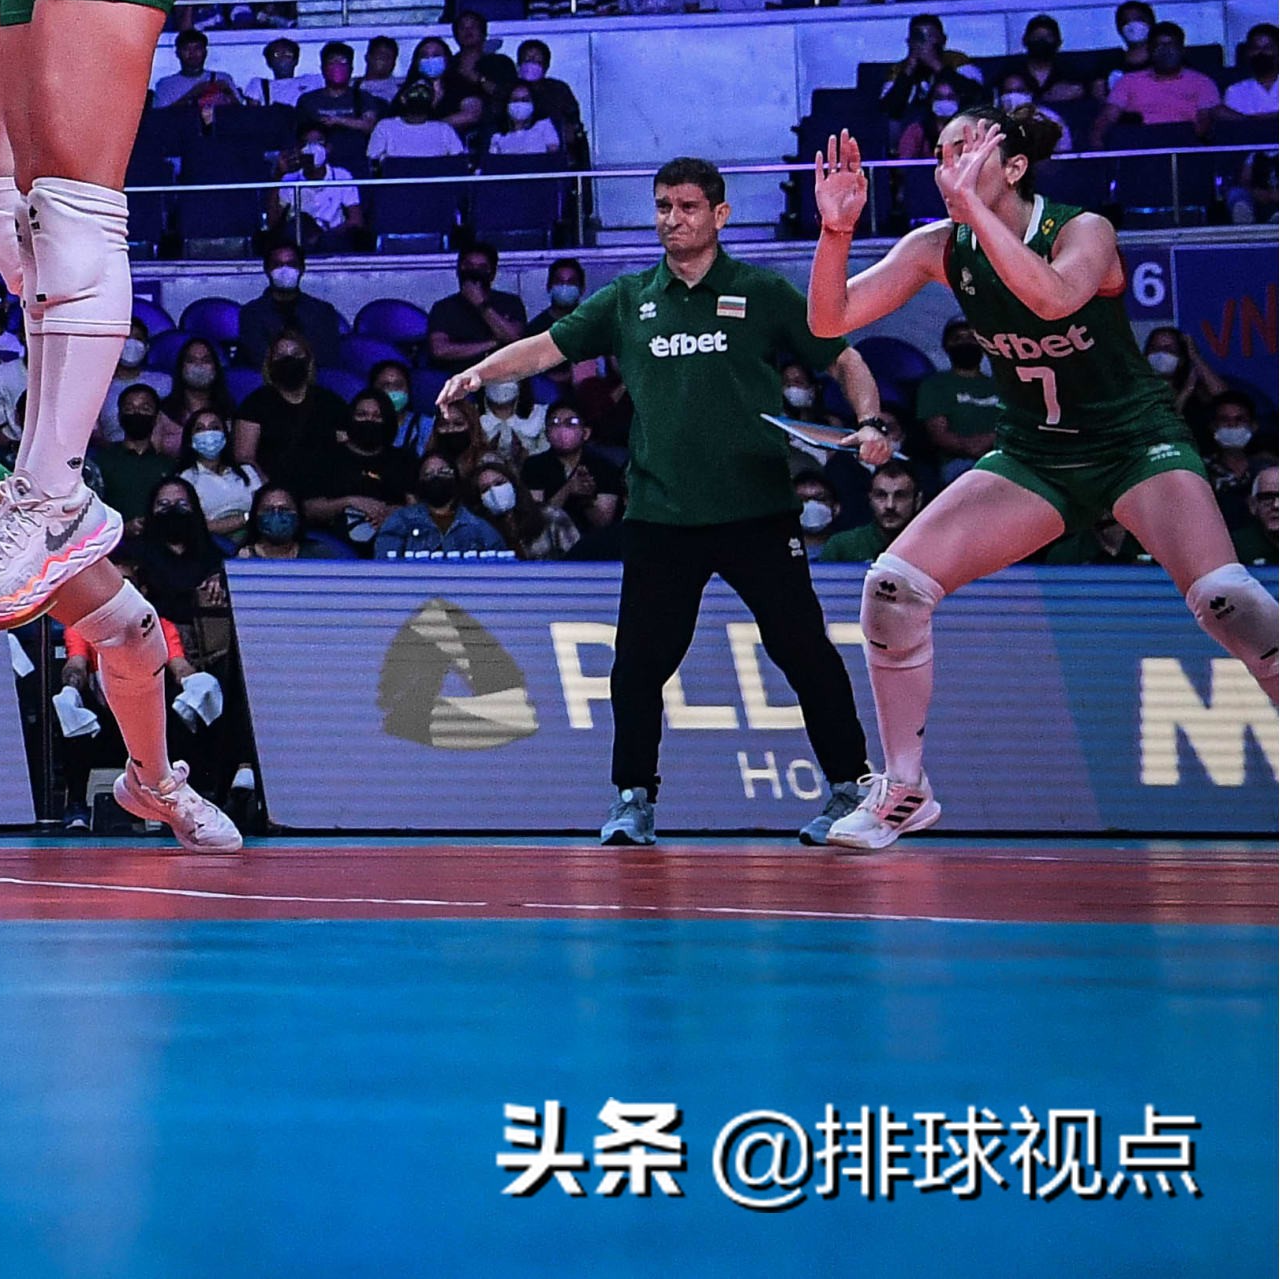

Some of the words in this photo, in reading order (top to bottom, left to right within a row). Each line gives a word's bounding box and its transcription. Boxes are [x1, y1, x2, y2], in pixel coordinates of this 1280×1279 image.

[648, 330, 729, 358] efbet
[973, 324, 1096, 361] efbet
[1202, 283, 1278, 359] VN
[1015, 366, 1062, 426] 7
